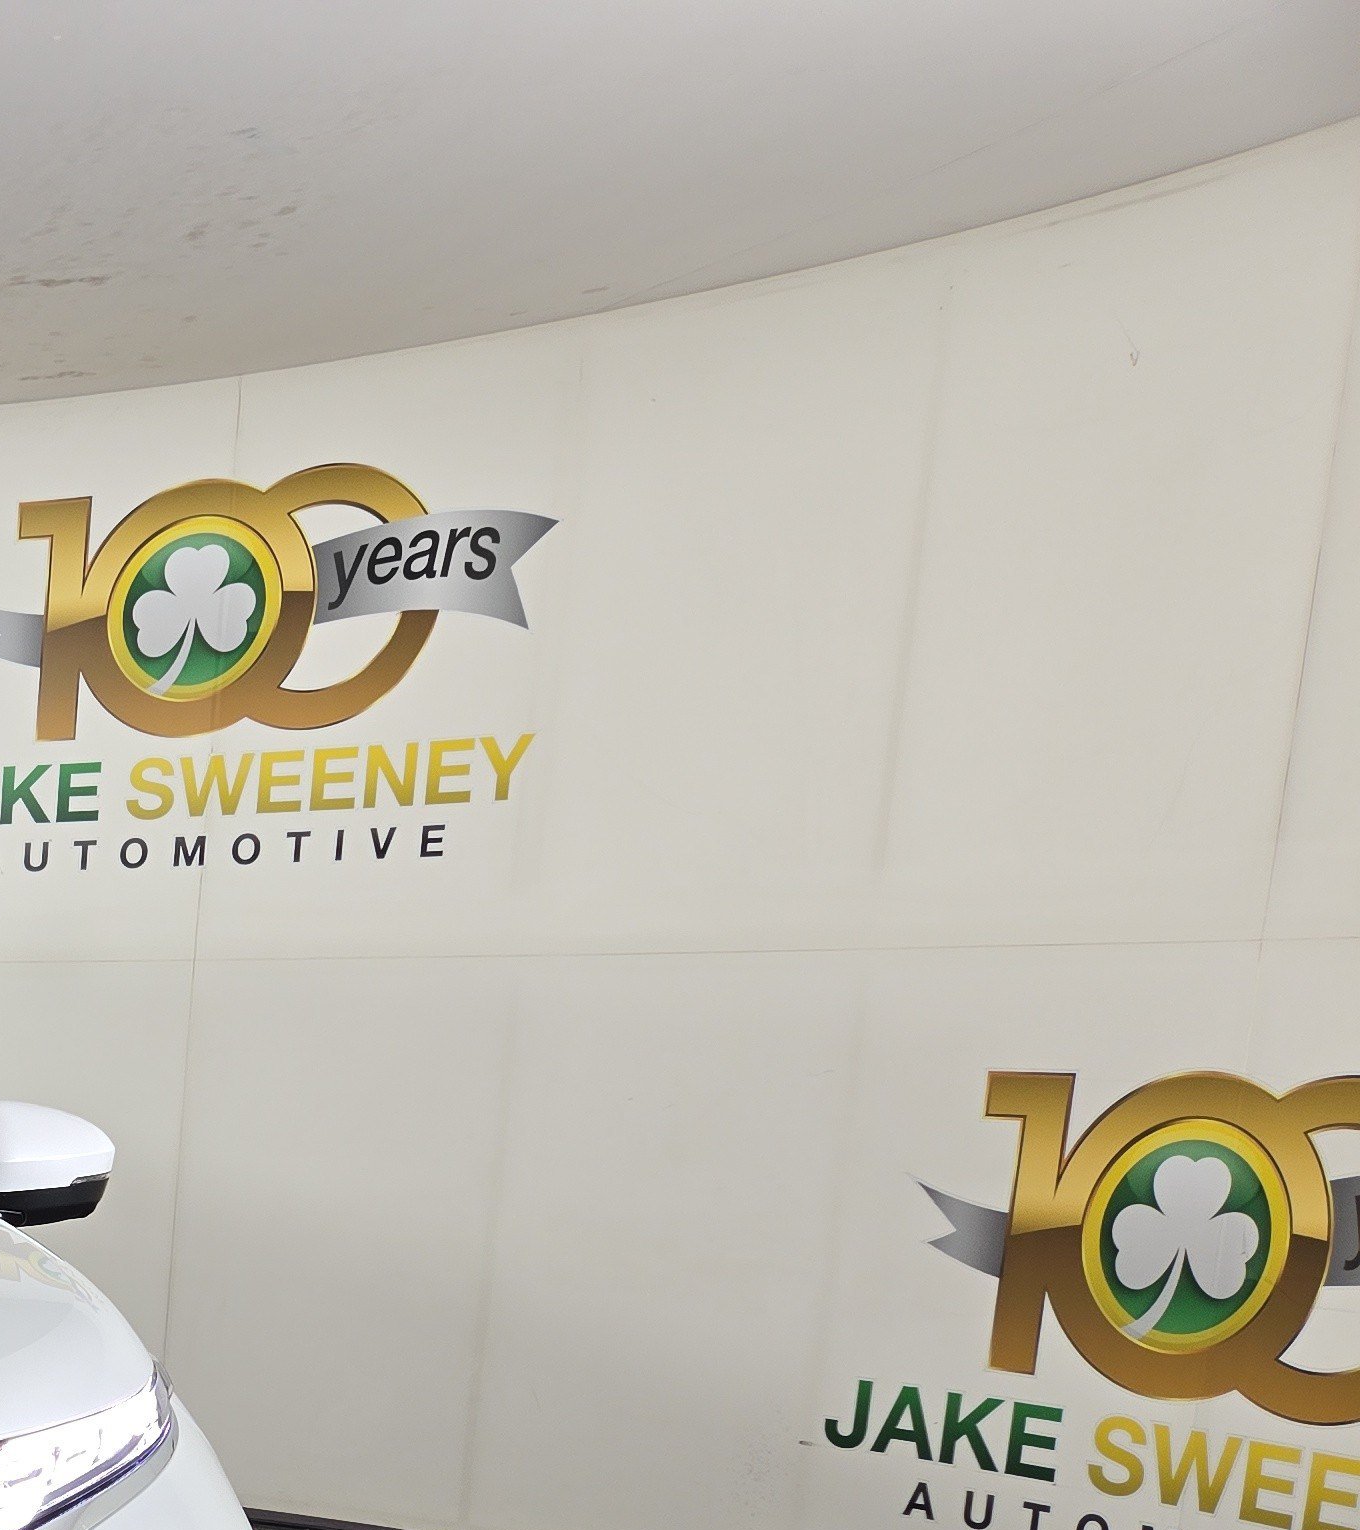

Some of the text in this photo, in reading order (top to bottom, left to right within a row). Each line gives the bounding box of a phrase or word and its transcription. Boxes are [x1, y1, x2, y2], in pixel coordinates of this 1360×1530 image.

[18, 461, 500, 742] 100 years
[125, 732, 537, 821] SWEENEY
[824, 1379, 1064, 1483] JAKE
